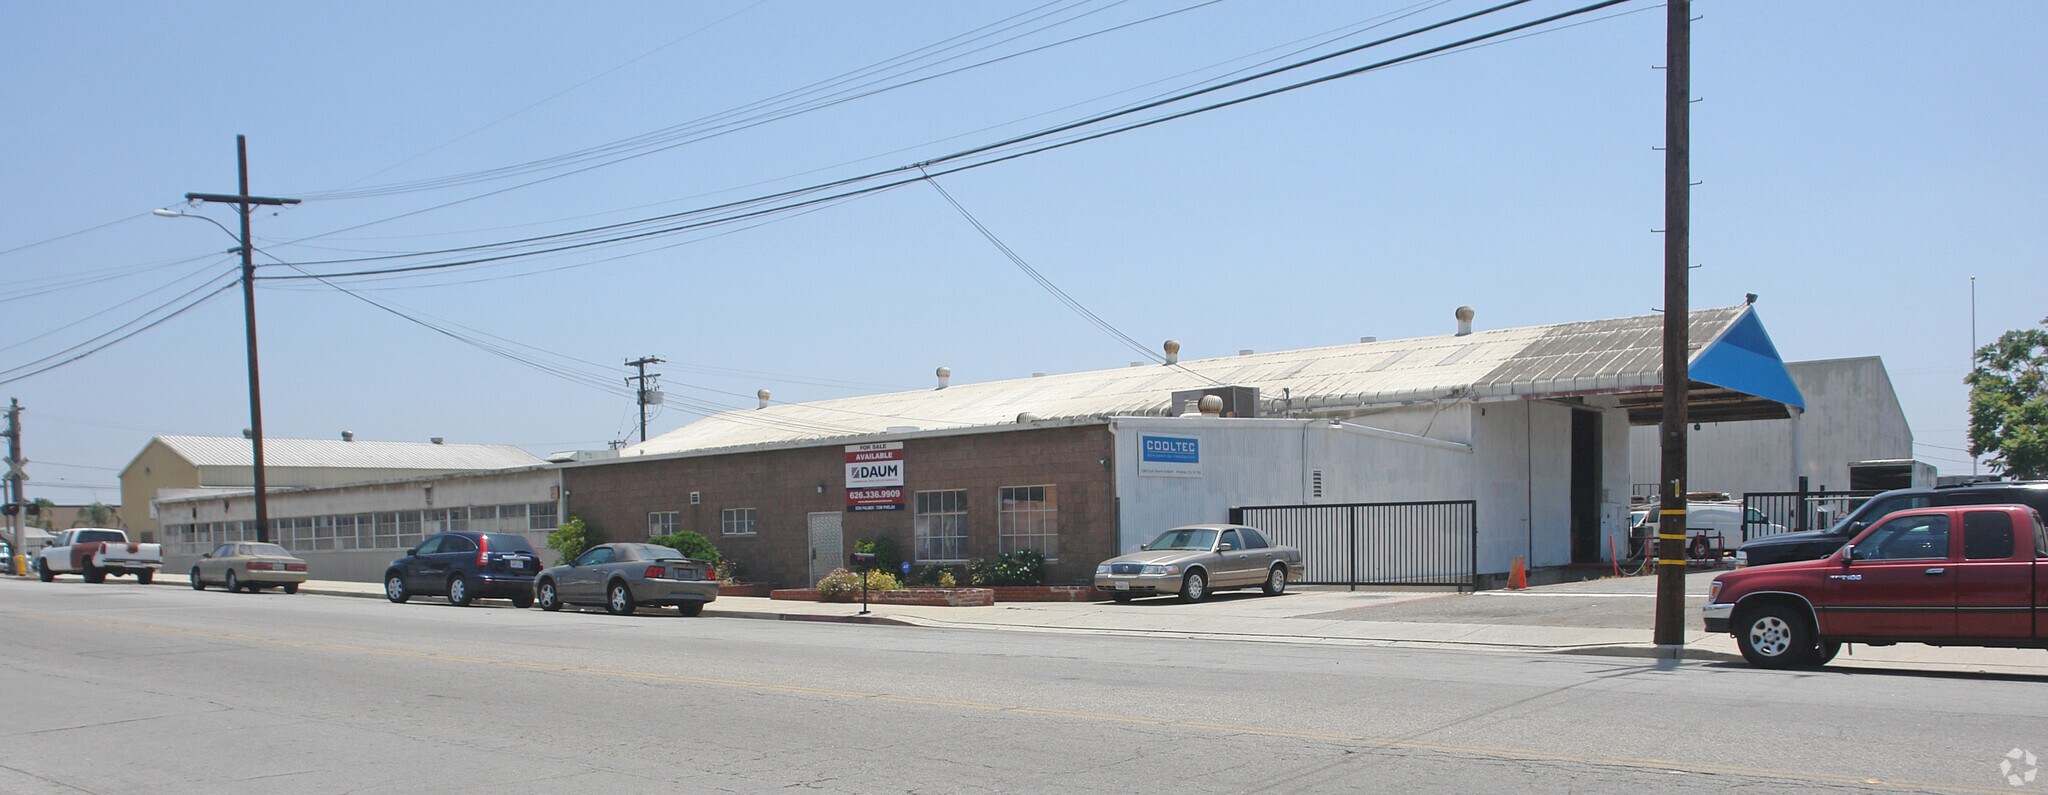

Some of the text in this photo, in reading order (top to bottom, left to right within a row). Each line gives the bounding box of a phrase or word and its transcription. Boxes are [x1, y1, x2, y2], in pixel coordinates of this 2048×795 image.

[1147, 440, 1195, 452] COOLTEC
[856, 452, 893, 460] AVAILABLE
[861, 465, 898, 478] DAUM
[849, 490, 901, 499] 626.336.9909
